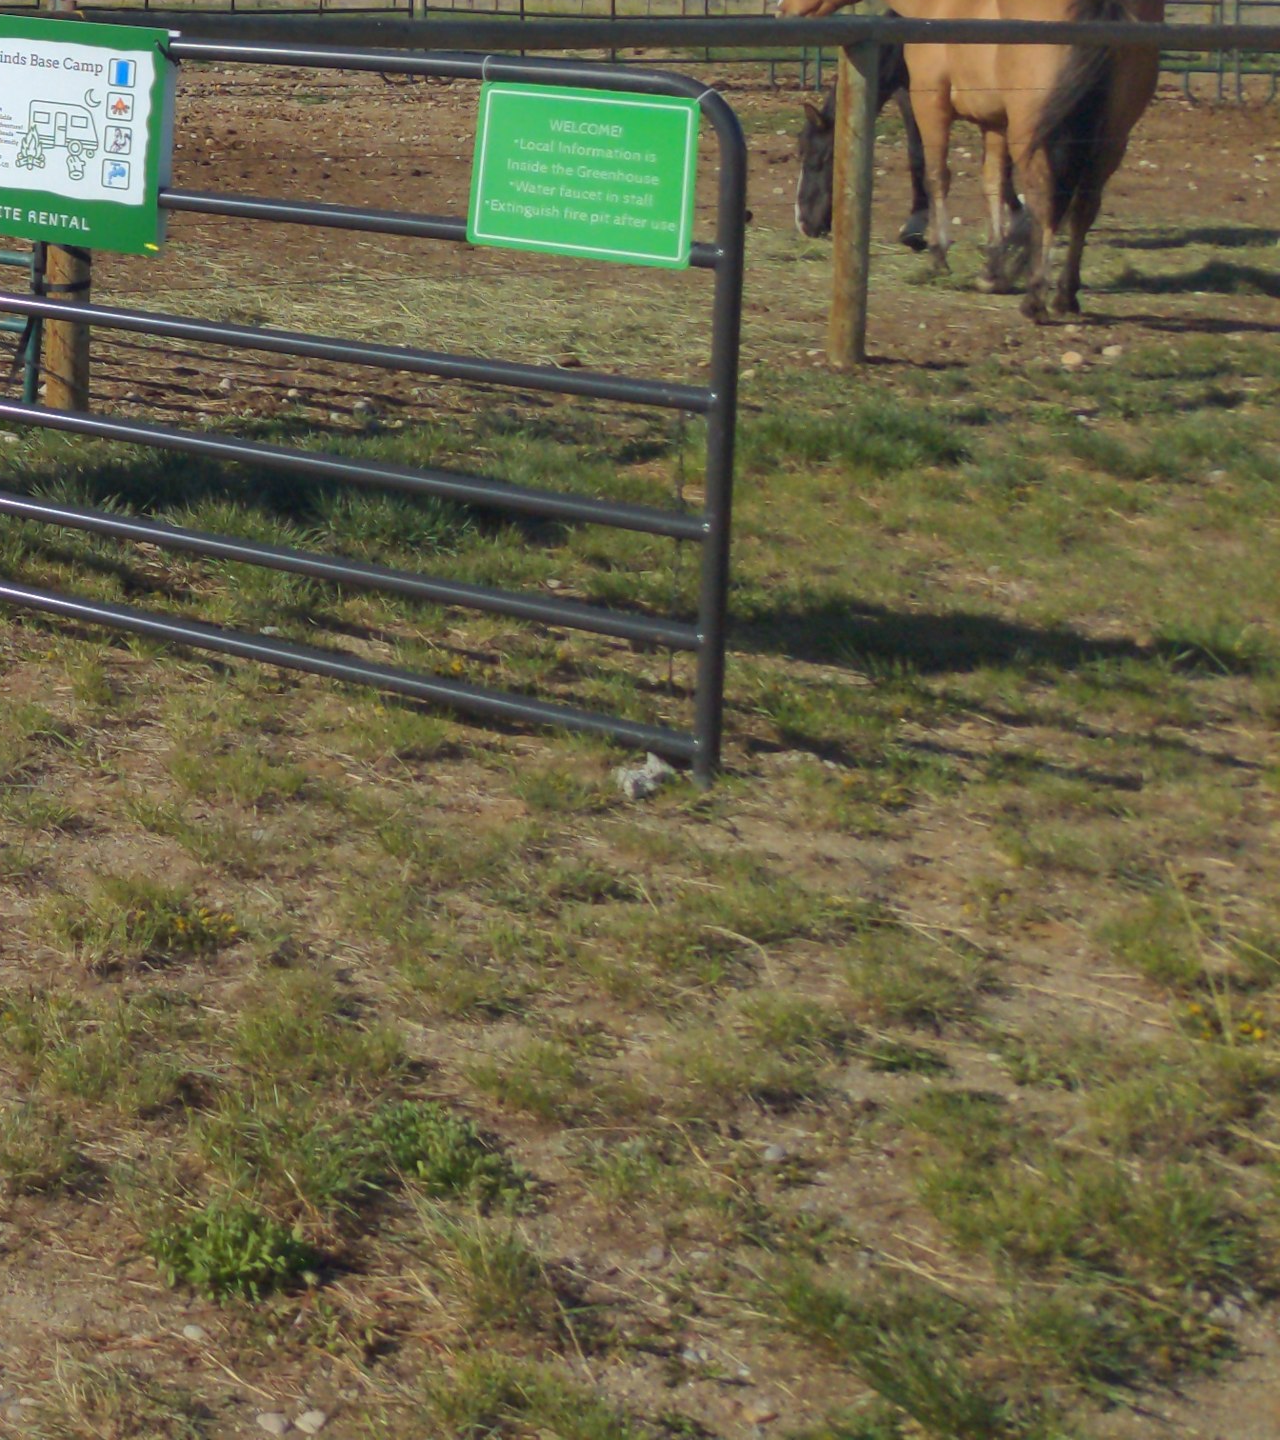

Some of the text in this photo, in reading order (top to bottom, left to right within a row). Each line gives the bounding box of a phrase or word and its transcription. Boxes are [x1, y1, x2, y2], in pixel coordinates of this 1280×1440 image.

[30, 53, 60, 69] Base
[63, 58, 103, 76] Camp
[550, 119, 624, 138] WELCOME!
[558, 144, 641, 162] Information
[644, 153, 657, 163] is
[506, 158, 660, 186] Inside the Greenhouse
[559, 185, 602, 202] faucet
[606, 190, 619, 203] in
[623, 192, 654, 207] stall
[28, 210, 90, 231] RENTAL
[564, 207, 587, 221] fire
[590, 212, 609, 226] pit
[613, 212, 647, 228] after
[651, 221, 676, 232] use
